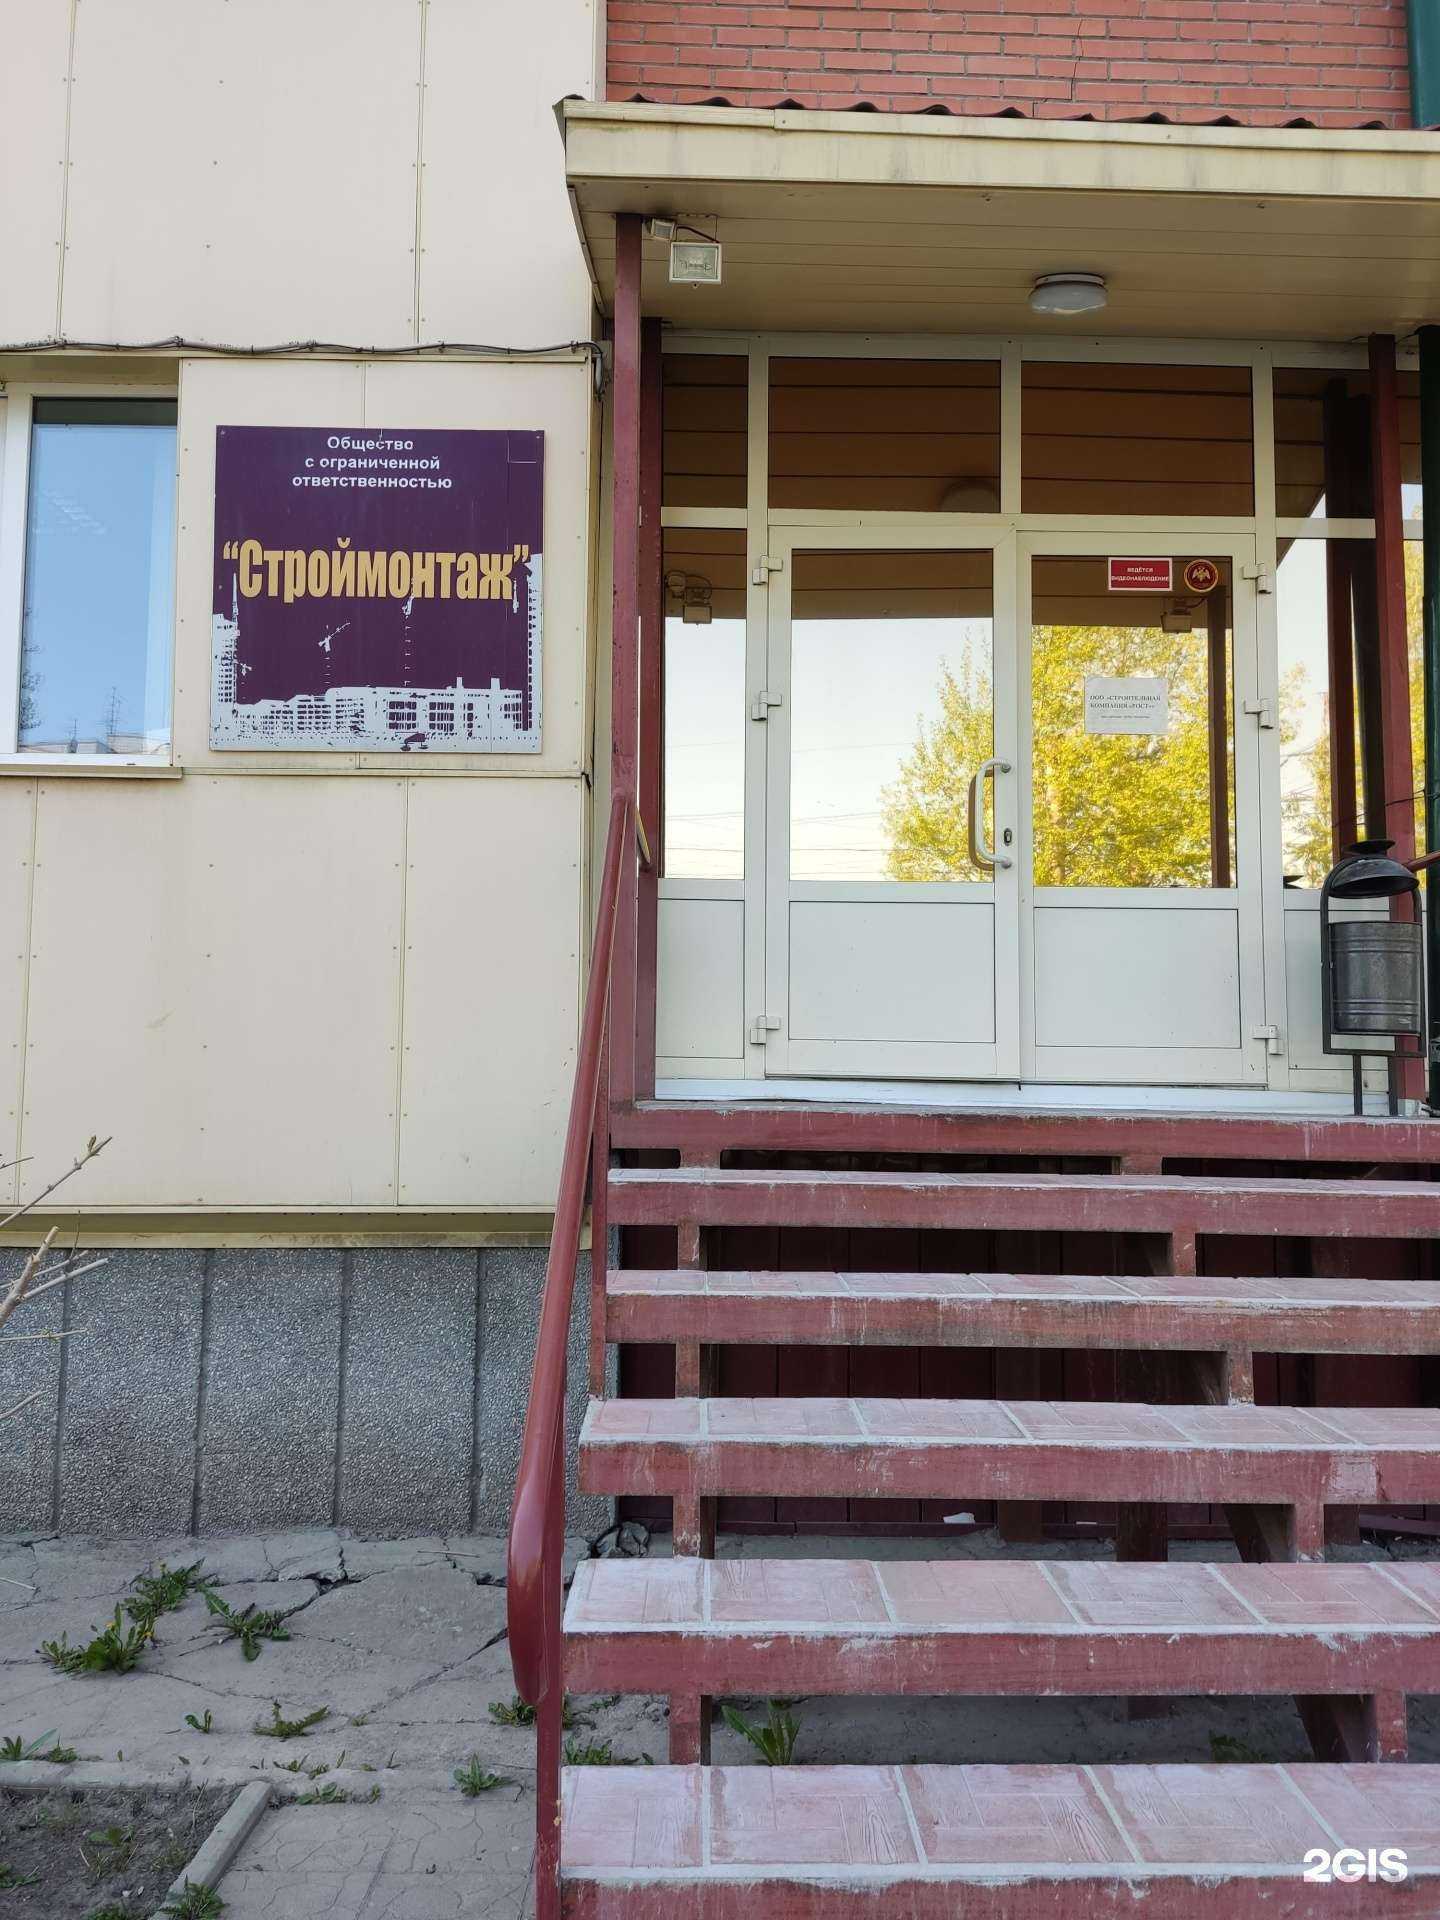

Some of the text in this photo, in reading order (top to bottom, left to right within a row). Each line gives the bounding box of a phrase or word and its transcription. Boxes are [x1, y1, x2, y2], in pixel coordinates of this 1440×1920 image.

[327, 436, 414, 452] Общество
[305, 456, 441, 470] с ограниченной
[292, 475, 452, 489] ответственностью
